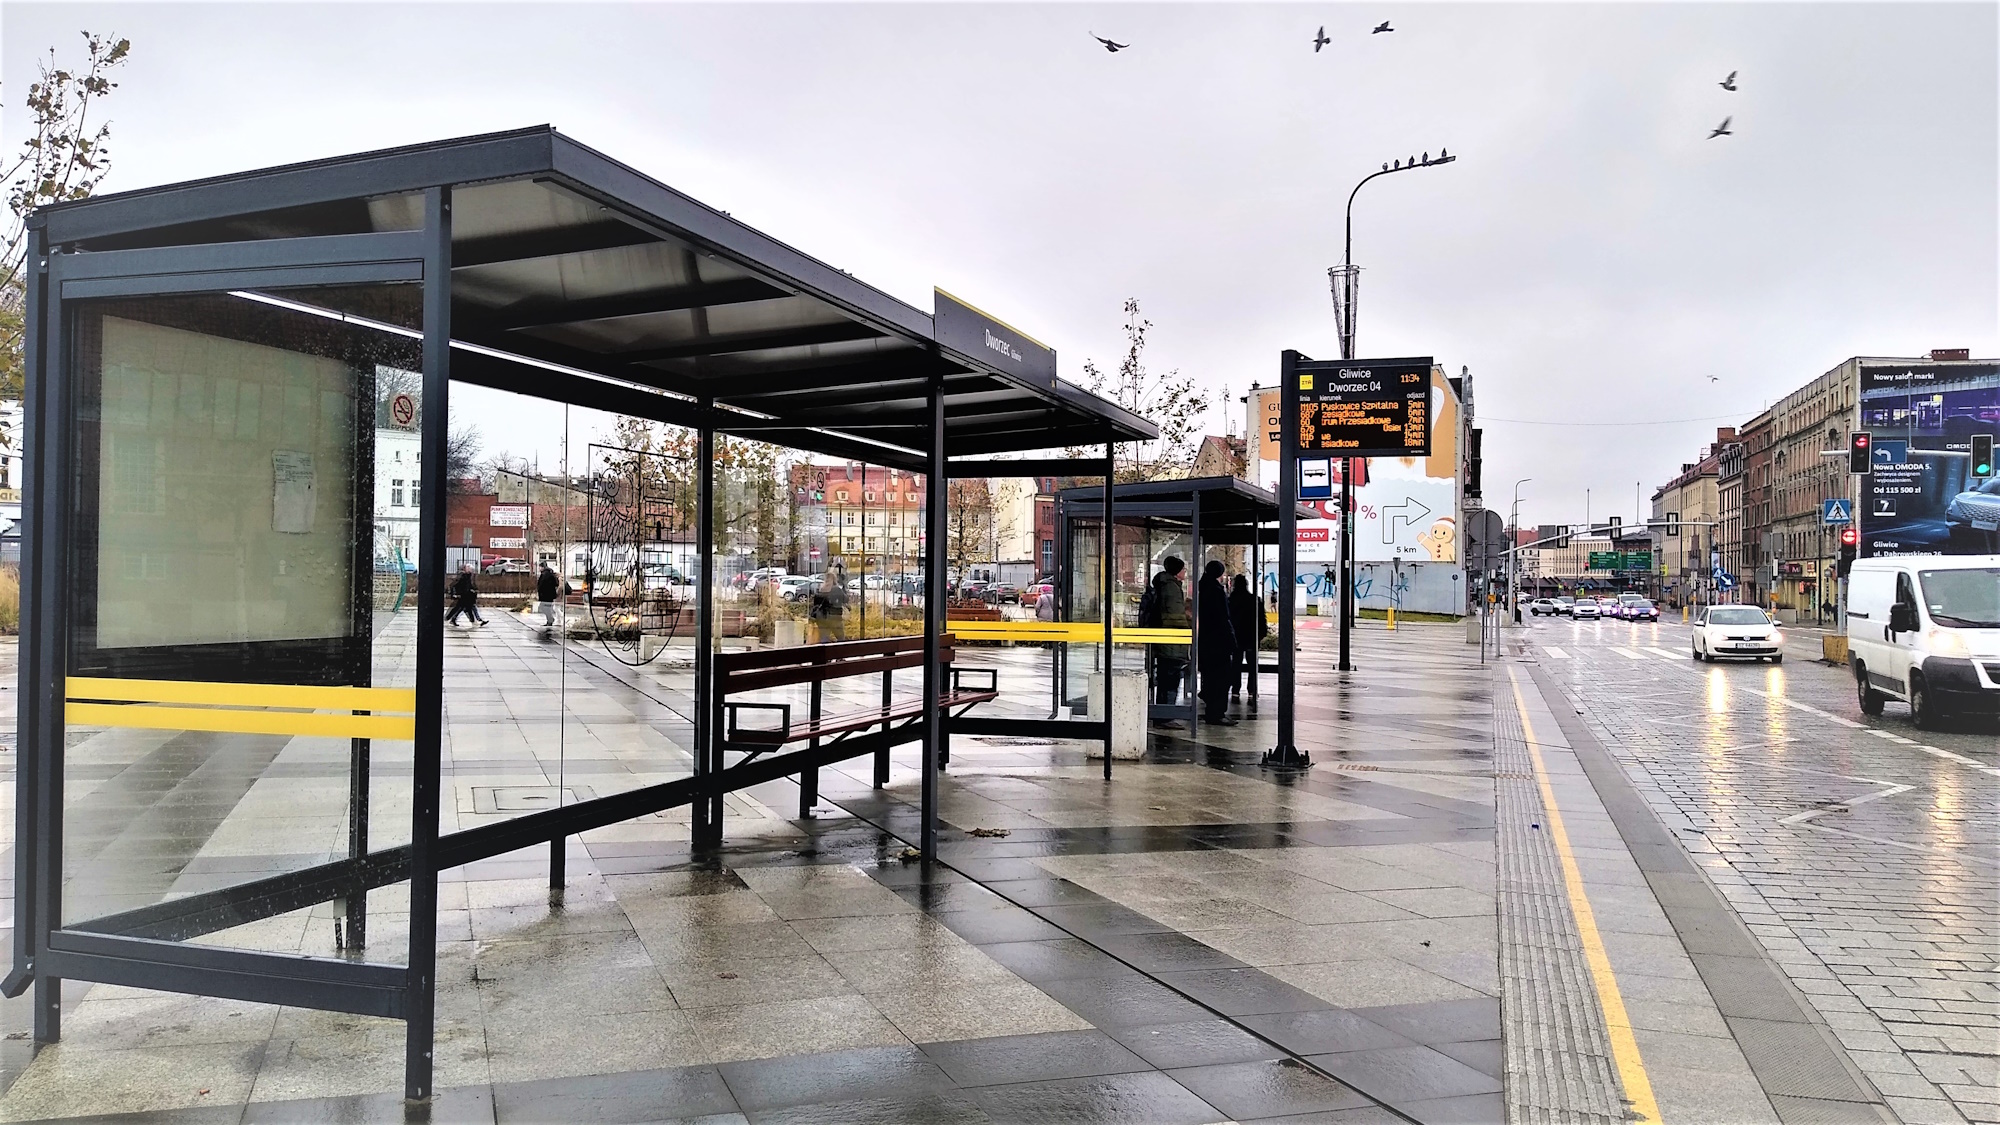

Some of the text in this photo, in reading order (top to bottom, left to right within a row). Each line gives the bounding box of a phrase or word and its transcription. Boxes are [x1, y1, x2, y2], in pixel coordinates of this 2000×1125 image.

[985, 328, 1010, 357] Dworzec
[1339, 368, 1372, 379] Gliwice
[1400, 373, 1420, 383] 11:34
[1328, 381, 1382, 393] Dworzec 04
[1406, 391, 1425, 400] odjazd
[1300, 400, 1425, 412] M105 Pyskowice Szpitalna 5min
[1300, 411, 1316, 419] 687
[1407, 408, 1425, 417] 6min
[1300, 418, 1310, 426] 60
[1408, 416, 1425, 424] 7min
[1403, 423, 1425, 431] 13min
[1300, 433, 1315, 441] M16
[1300, 440, 1310, 448] 41
[1403, 438, 1425, 447] 18min
[1873, 486, 1922, 494] Od 115 500 zł
[1880, 499, 1890, 512] 7
[1361, 505, 1377, 519] %
[1396, 546, 1417, 554] 5 km
